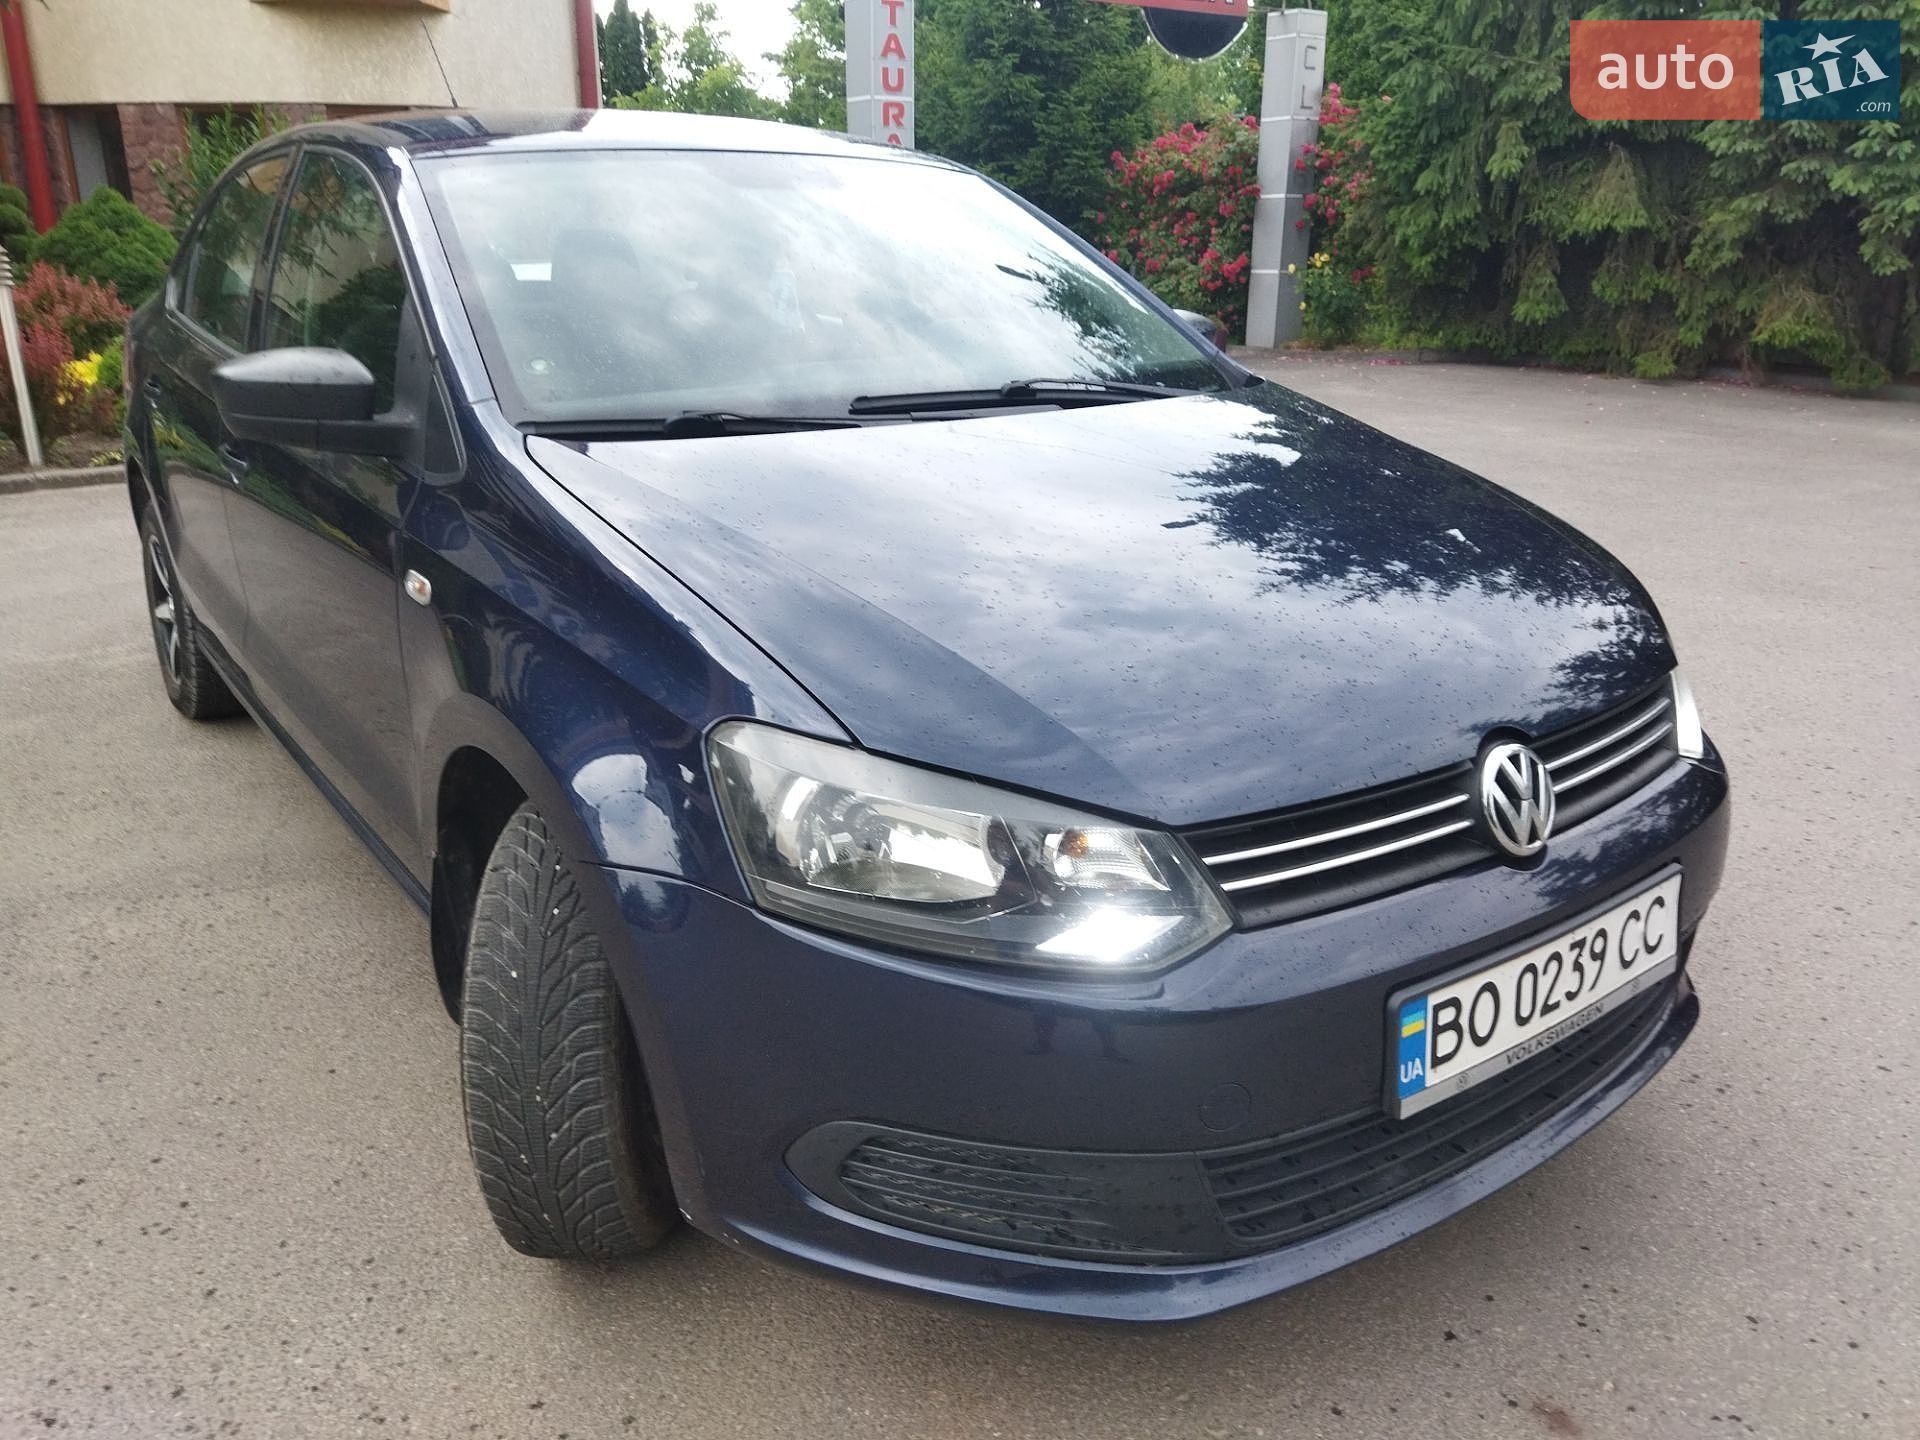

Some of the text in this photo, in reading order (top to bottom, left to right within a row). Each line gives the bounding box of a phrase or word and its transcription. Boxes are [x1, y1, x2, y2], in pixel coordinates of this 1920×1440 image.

[1431, 896, 1665, 1069] BO 0239 CC
[1505, 1002, 1604, 1065] VOLKSWAGEN
[1400, 1057, 1424, 1083] UA
